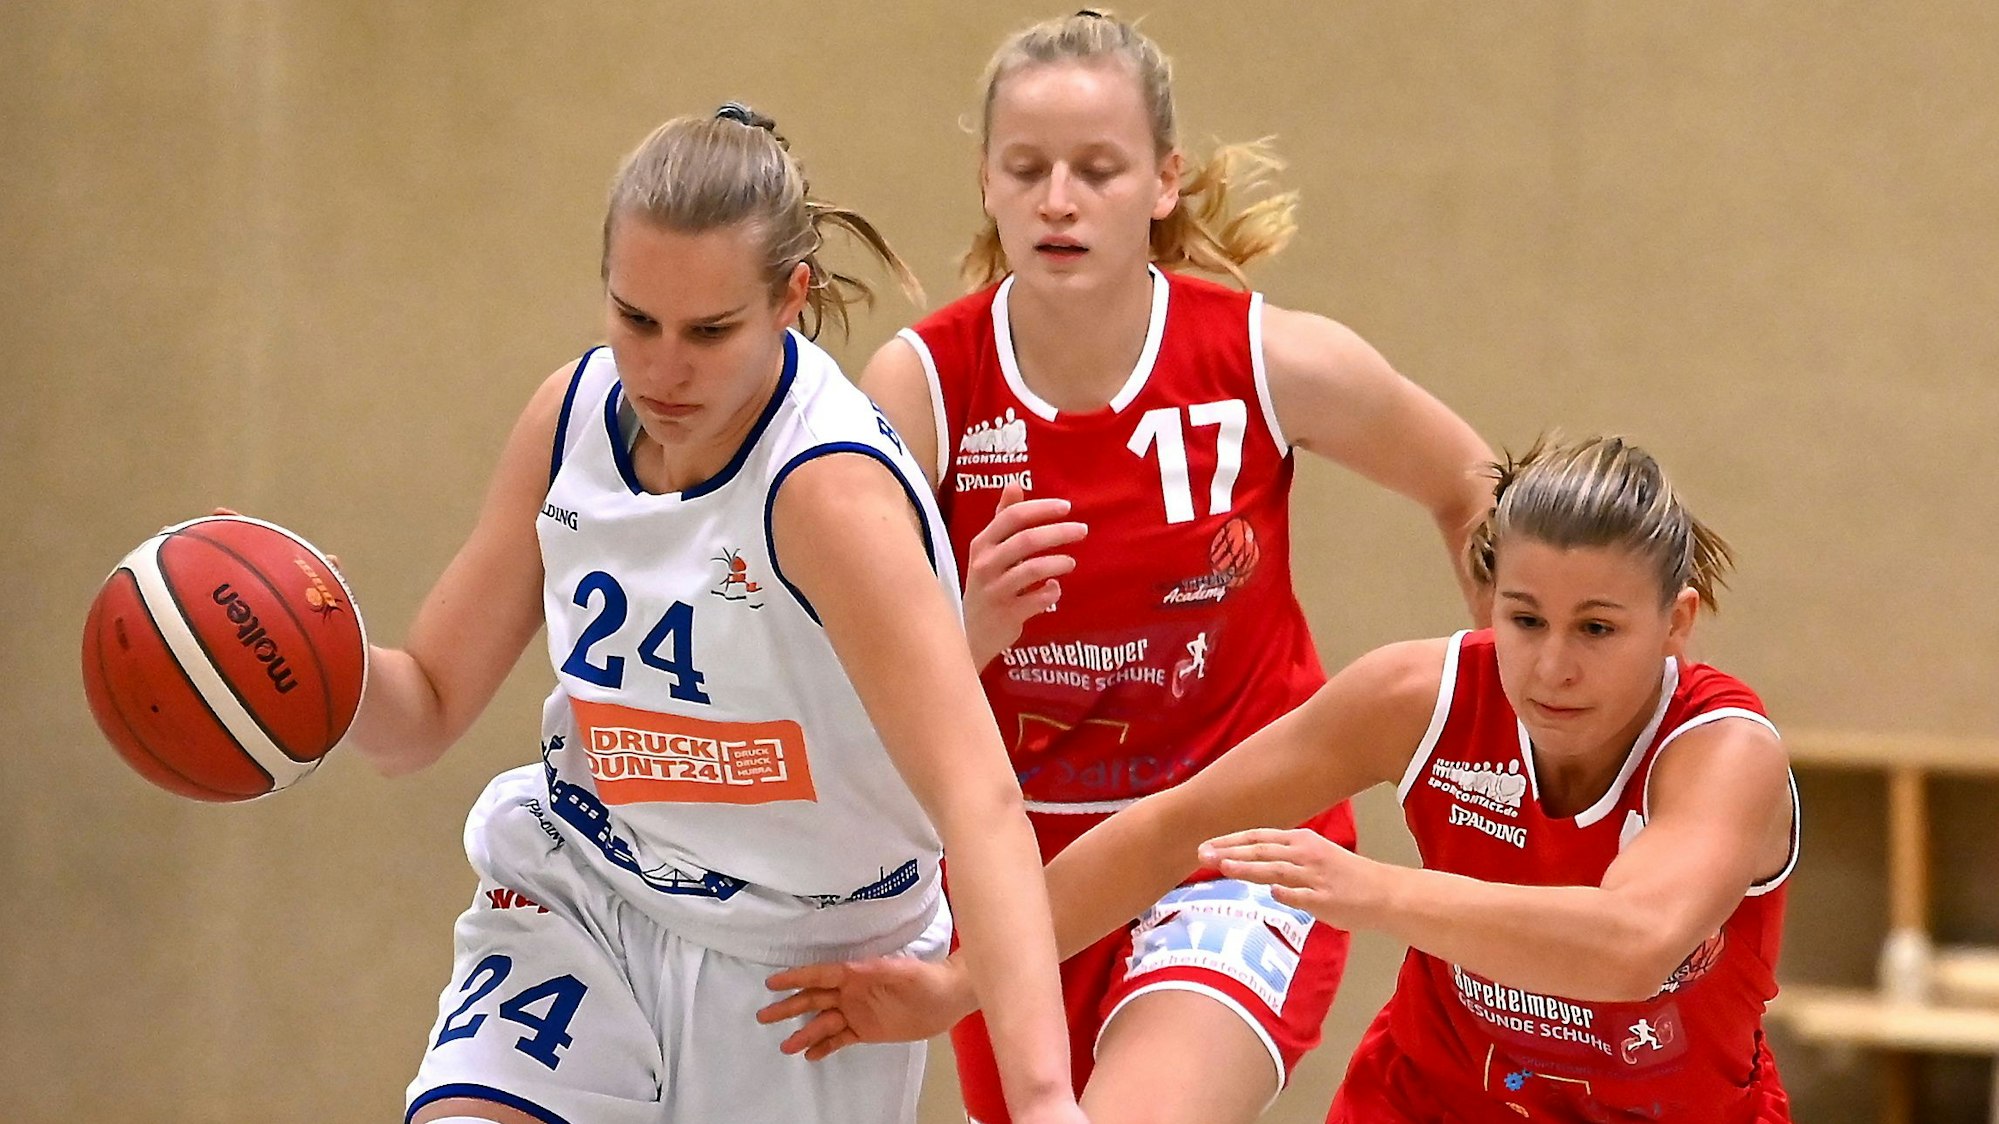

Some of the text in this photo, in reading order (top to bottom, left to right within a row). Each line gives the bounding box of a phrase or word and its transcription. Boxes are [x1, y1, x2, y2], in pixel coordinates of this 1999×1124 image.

[955, 470, 1033, 492] SPALDING
[1126, 399, 1248, 524] 17
[1163, 584, 1226, 603] Academy
[212, 583, 298, 694] molten
[560, 570, 711, 704] 24
[1001, 639, 1148, 672] Sprekelmeyer
[1008, 667, 1166, 692] GESUNDE SCHUHE
[593, 730, 716, 759] DRUCK
[734, 748, 770, 759] DRUCK
[736, 757, 772, 768] DRUCK
[1449, 803, 1527, 849] SPALDING
[433, 954, 589, 1071] 24
[1453, 963, 1594, 1029] Sprekelmeyer
[1458, 991, 1613, 1056] GESUNDE SCHUHE
